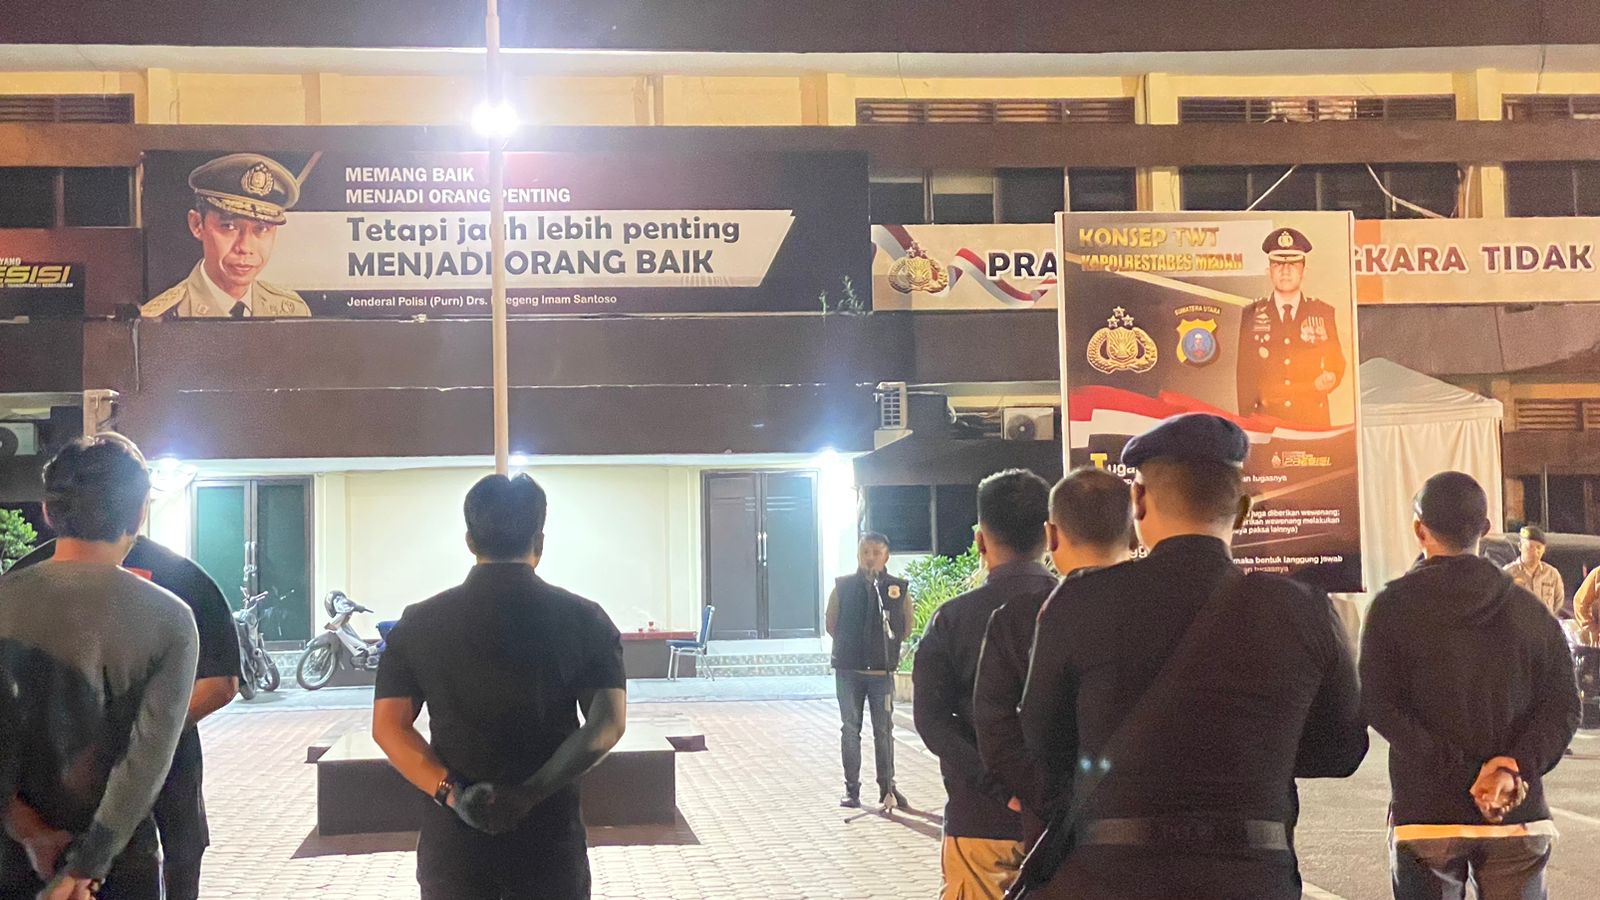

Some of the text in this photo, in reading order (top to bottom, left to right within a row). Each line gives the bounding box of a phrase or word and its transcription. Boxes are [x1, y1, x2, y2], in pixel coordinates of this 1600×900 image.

[345, 167, 475, 182] MEMANG BAIK
[345, 189, 424, 204] MENJADI
[428, 188, 491, 203] ORANG
[347, 217, 447, 246] Tetapi
[537, 216, 612, 240] lebih
[623, 216, 740, 244] penting
[1079, 227, 1219, 247] KONSEP TWT
[349, 249, 714, 280] MENJADI ORANG BAIK
[1081, 252, 1243, 272] KAPOLRESTABES MEDAN
[1482, 245, 1592, 271] TIDAK
[347, 293, 617, 307] Jenderal Polisi (Purn) Drs. egeng Imam Santoso
[1252, 474, 1287, 483] tugasnya
[1265, 518, 1301, 526] wewenang
[1248, 527, 1270, 535] paksa
[1255, 556, 1282, 564] bentuk
[1283, 556, 1319, 565] tanggung
[1319, 554, 1344, 564] jawab
